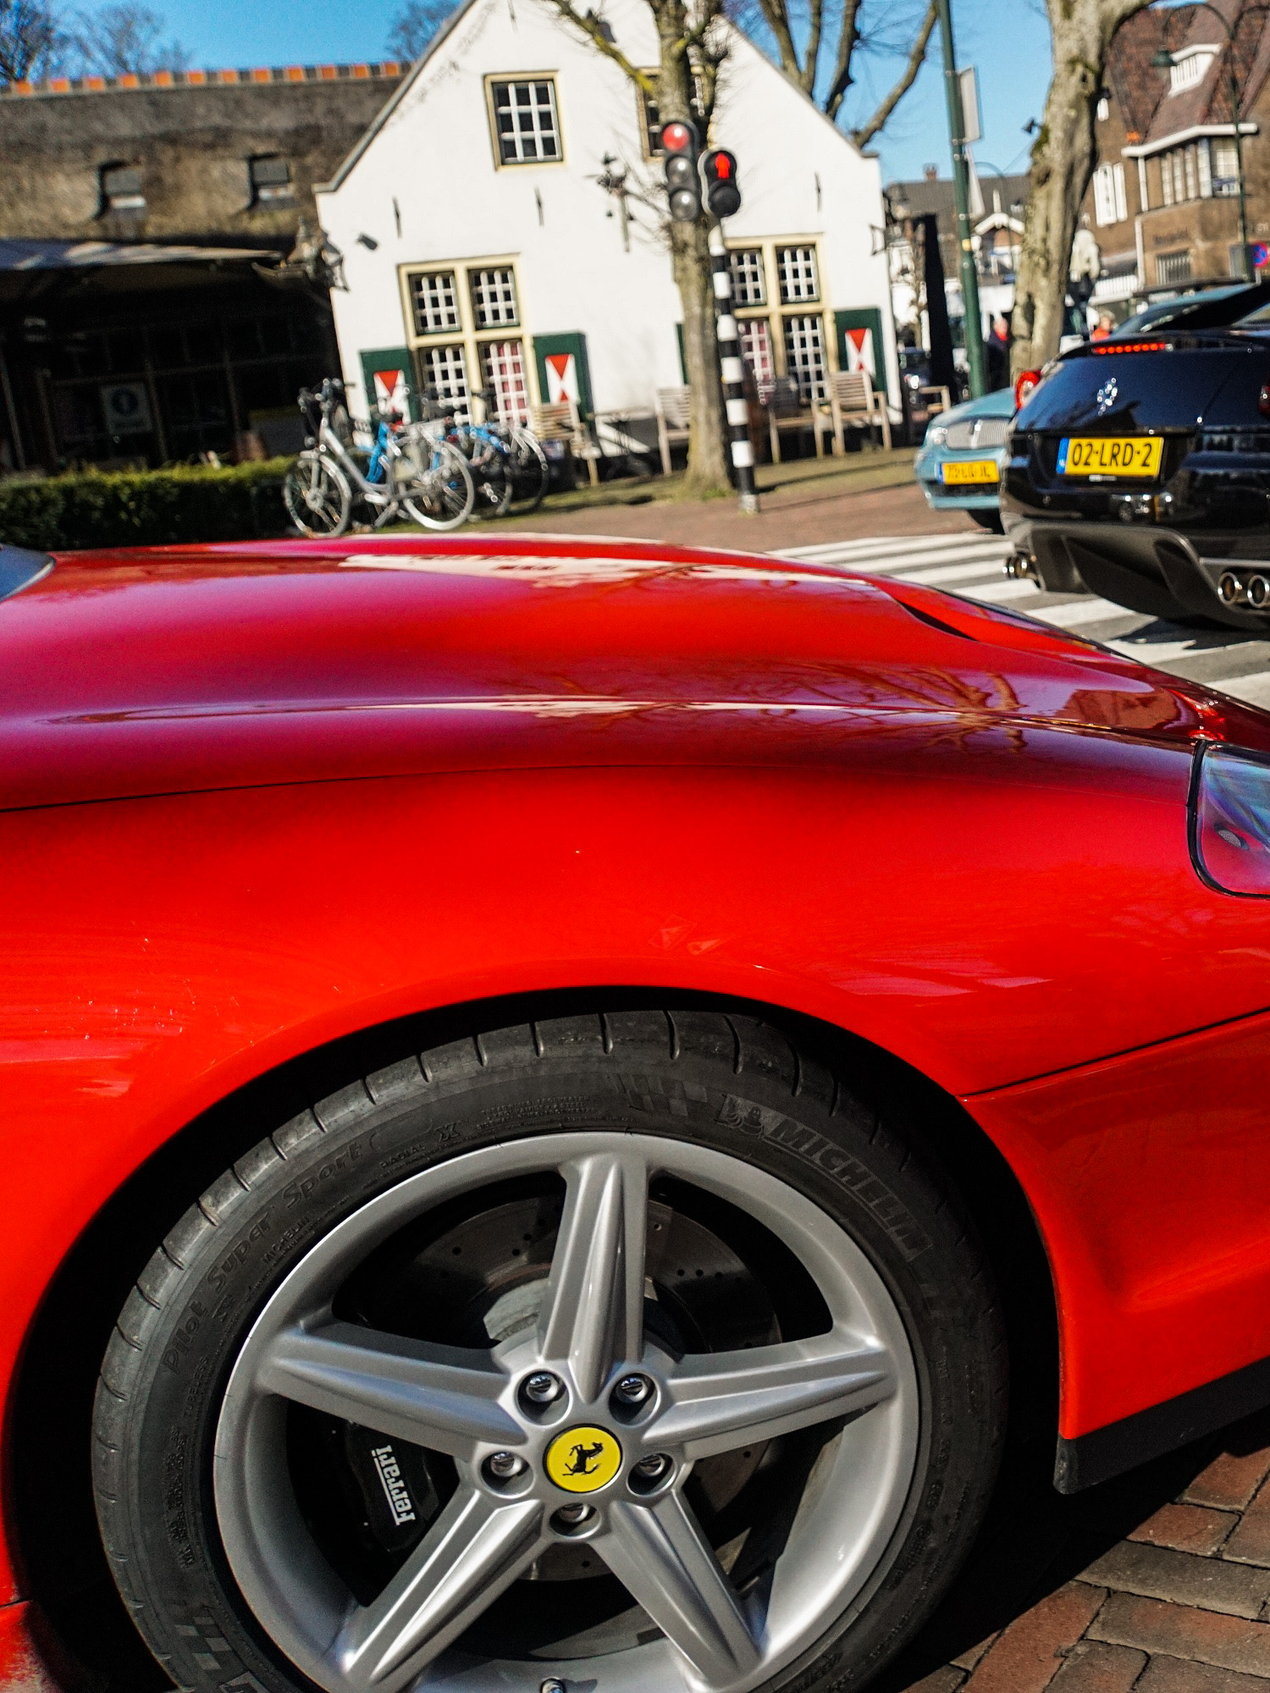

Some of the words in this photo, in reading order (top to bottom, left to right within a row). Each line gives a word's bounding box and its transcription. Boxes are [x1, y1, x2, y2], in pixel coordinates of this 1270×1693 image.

[1072, 443, 1153, 467] 02-LRD-2
[767, 1117, 934, 1261] MICHELIN
[162, 1300, 210, 1375] Pilot
[206, 1206, 274, 1293] Super
[282, 1142, 364, 1209] Sport
[371, 1445, 416, 1526] Ferrari
